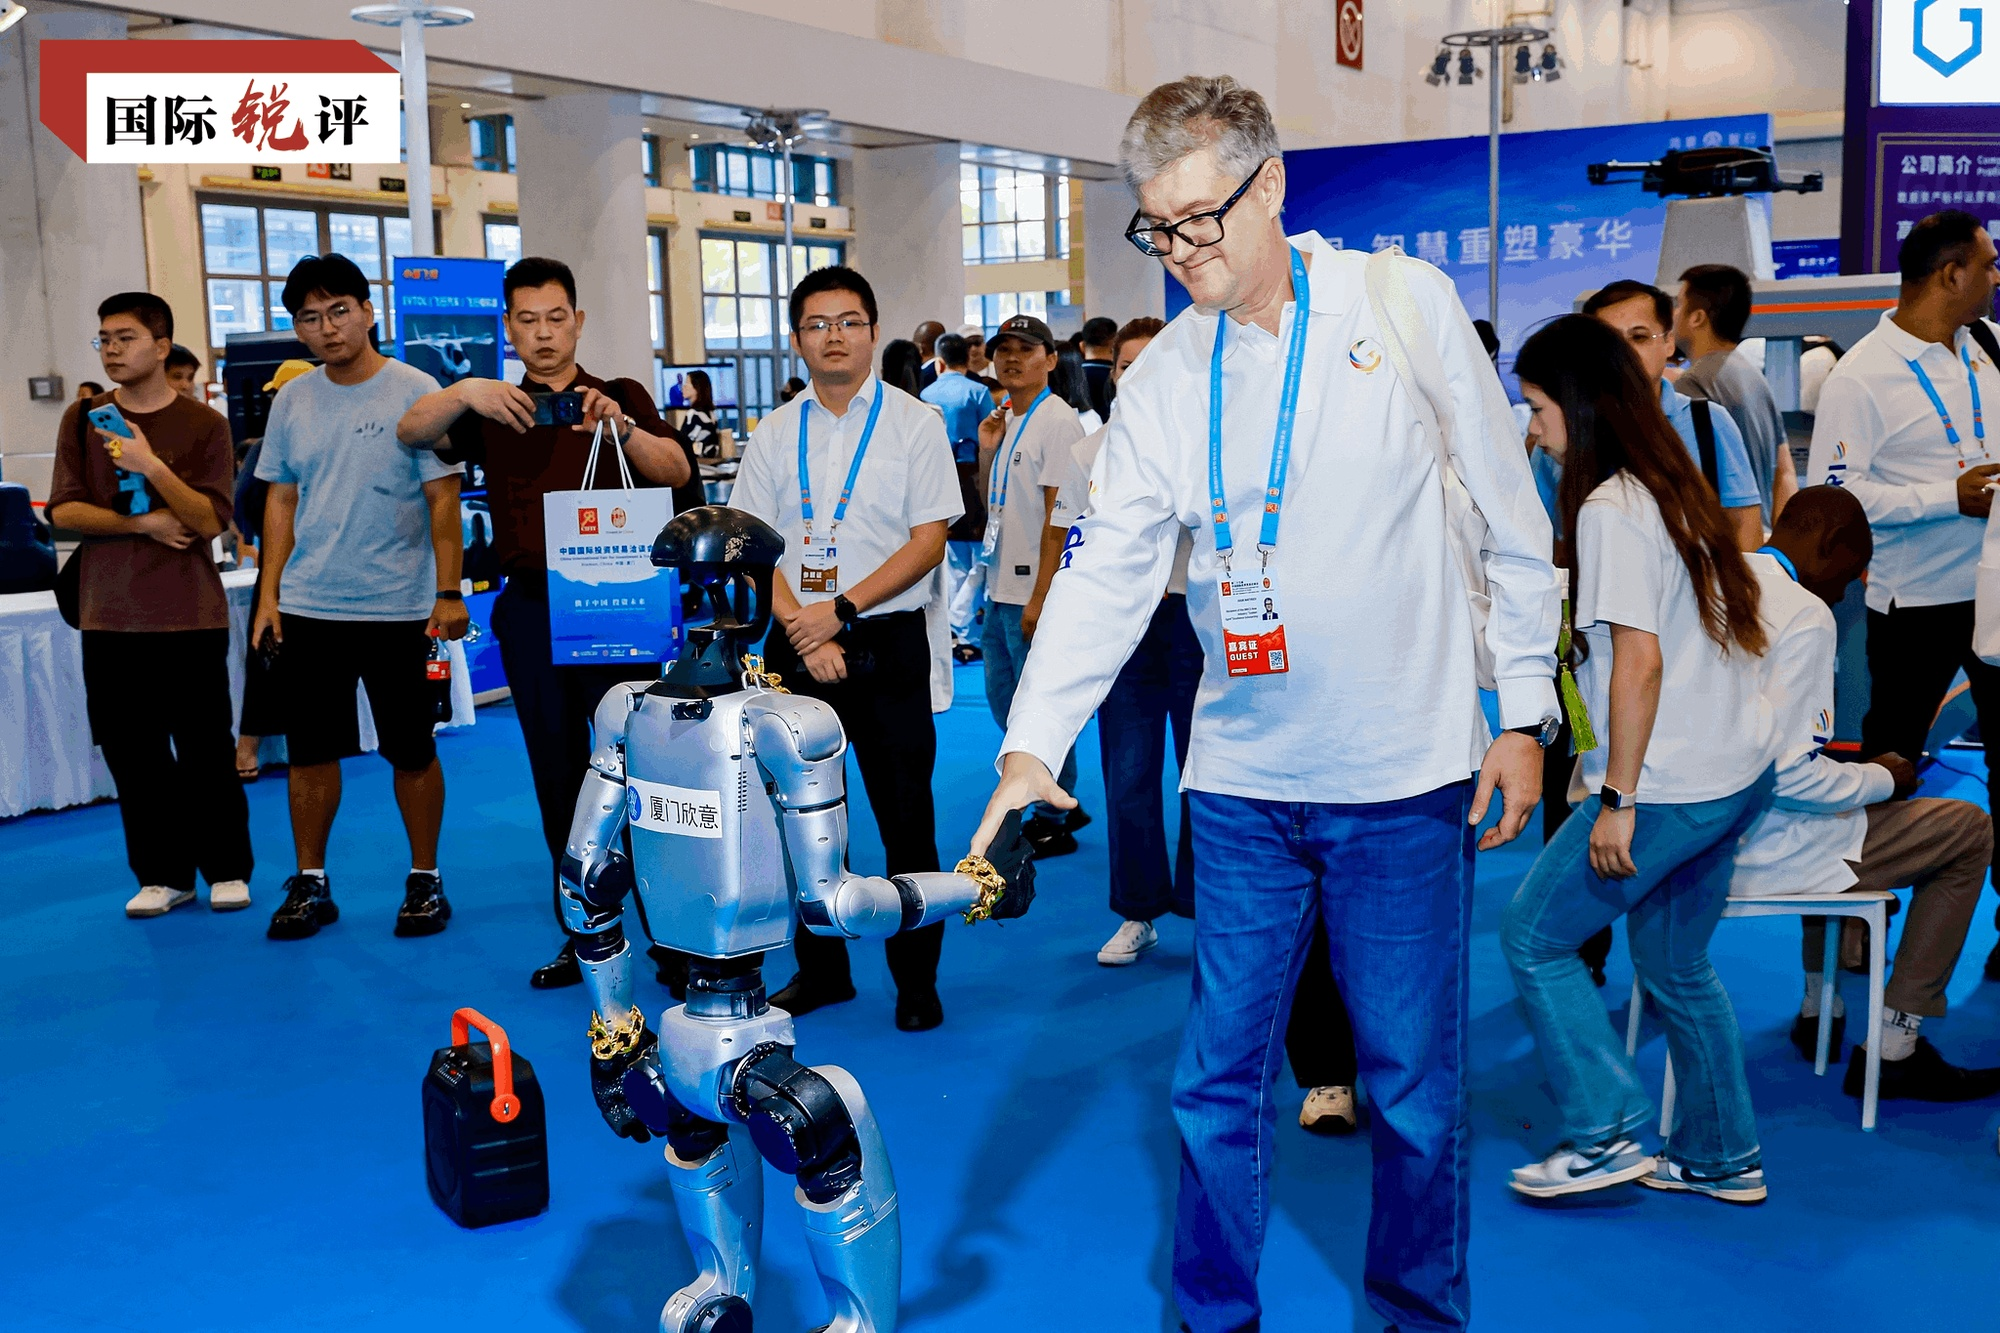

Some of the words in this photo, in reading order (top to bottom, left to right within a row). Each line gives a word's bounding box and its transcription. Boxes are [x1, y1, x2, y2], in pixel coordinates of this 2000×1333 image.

[1901, 155, 1972, 175] 公司简介
[1371, 219, 1632, 266] 智慧重塑豪华
[1228, 640, 1258, 652] 嘉宾证
[1230, 651, 1259, 661] GUEST
[650, 795, 719, 829] 厦门欣意
